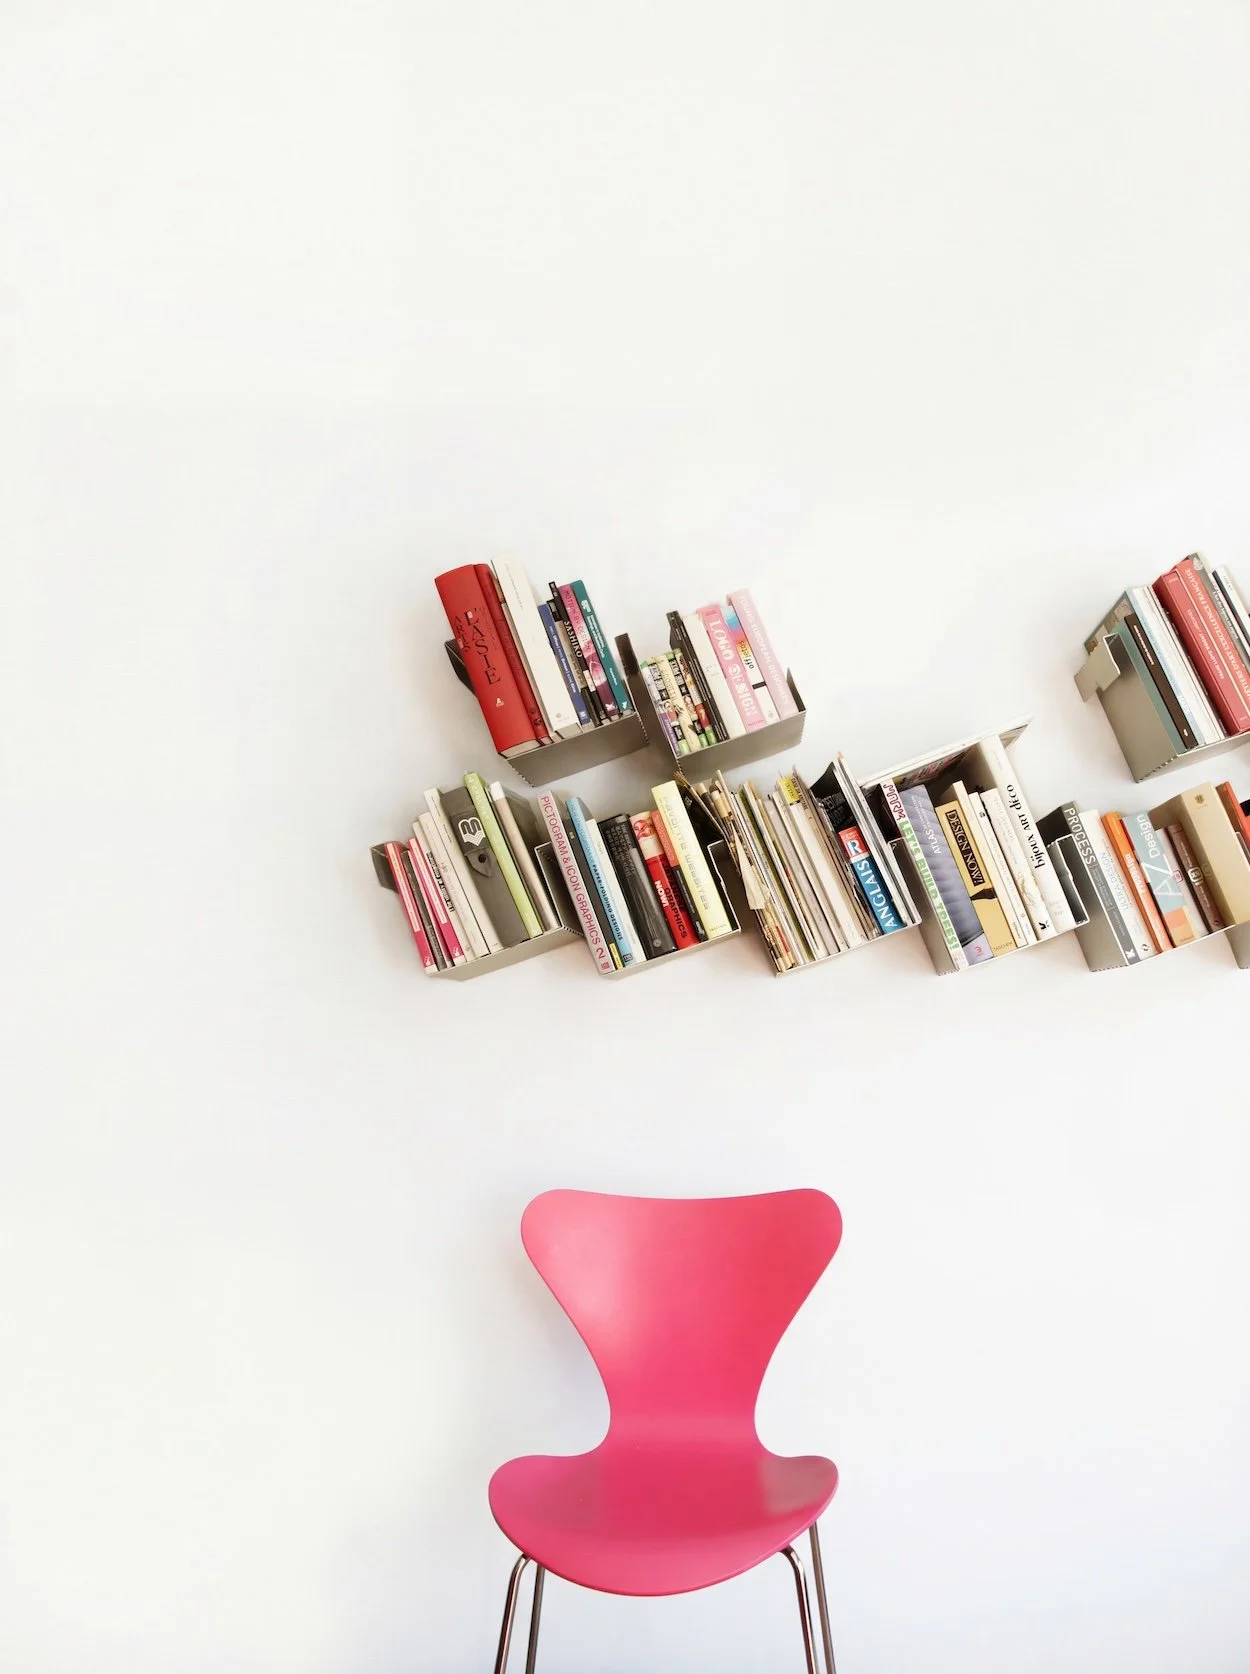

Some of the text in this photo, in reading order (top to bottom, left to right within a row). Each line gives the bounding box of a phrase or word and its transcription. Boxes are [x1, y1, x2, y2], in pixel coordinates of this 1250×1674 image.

[1184, 567, 1207, 604] FRANÇAISE
[563, 590, 577, 614] MOTION
[573, 615, 581, 624] BY
[563, 620, 582, 658] SASHIKO
[1202, 604, 1230, 650] L'EXCELLENCE
[708, 618, 758, 717] LOGO DESIGN
[1225, 649, 1239, 670] D'ART
[1003, 783, 1022, 812] déco
[1017, 812, 1031, 832] ART
[1063, 806, 1096, 865] PROCESS
[1134, 813, 1160, 858] Design
[925, 827, 941, 855] ATLAS
[946, 810, 983, 885] DESIGN NOW!
[1023, 832, 1046, 868] bijoux
[540, 795, 605, 959] PICTOGRAM & ICON GRAPHICS 2
[899, 819, 921, 856] LET'S
[914, 857, 939, 900] BUILD
[934, 904, 959, 950] TREES!
[1098, 851, 1118, 883] DESIGN
[591, 864, 612, 913] PAPER-FOLDING
[609, 913, 623, 941] DESIGNS
[653, 879, 669, 907] NOW!
[855, 858, 897, 931] ANGLAIS
[1113, 884, 1129, 910] ULTRA
[662, 887, 688, 939] GRAPHICS
[993, 941, 1013, 952] TASCHEN
